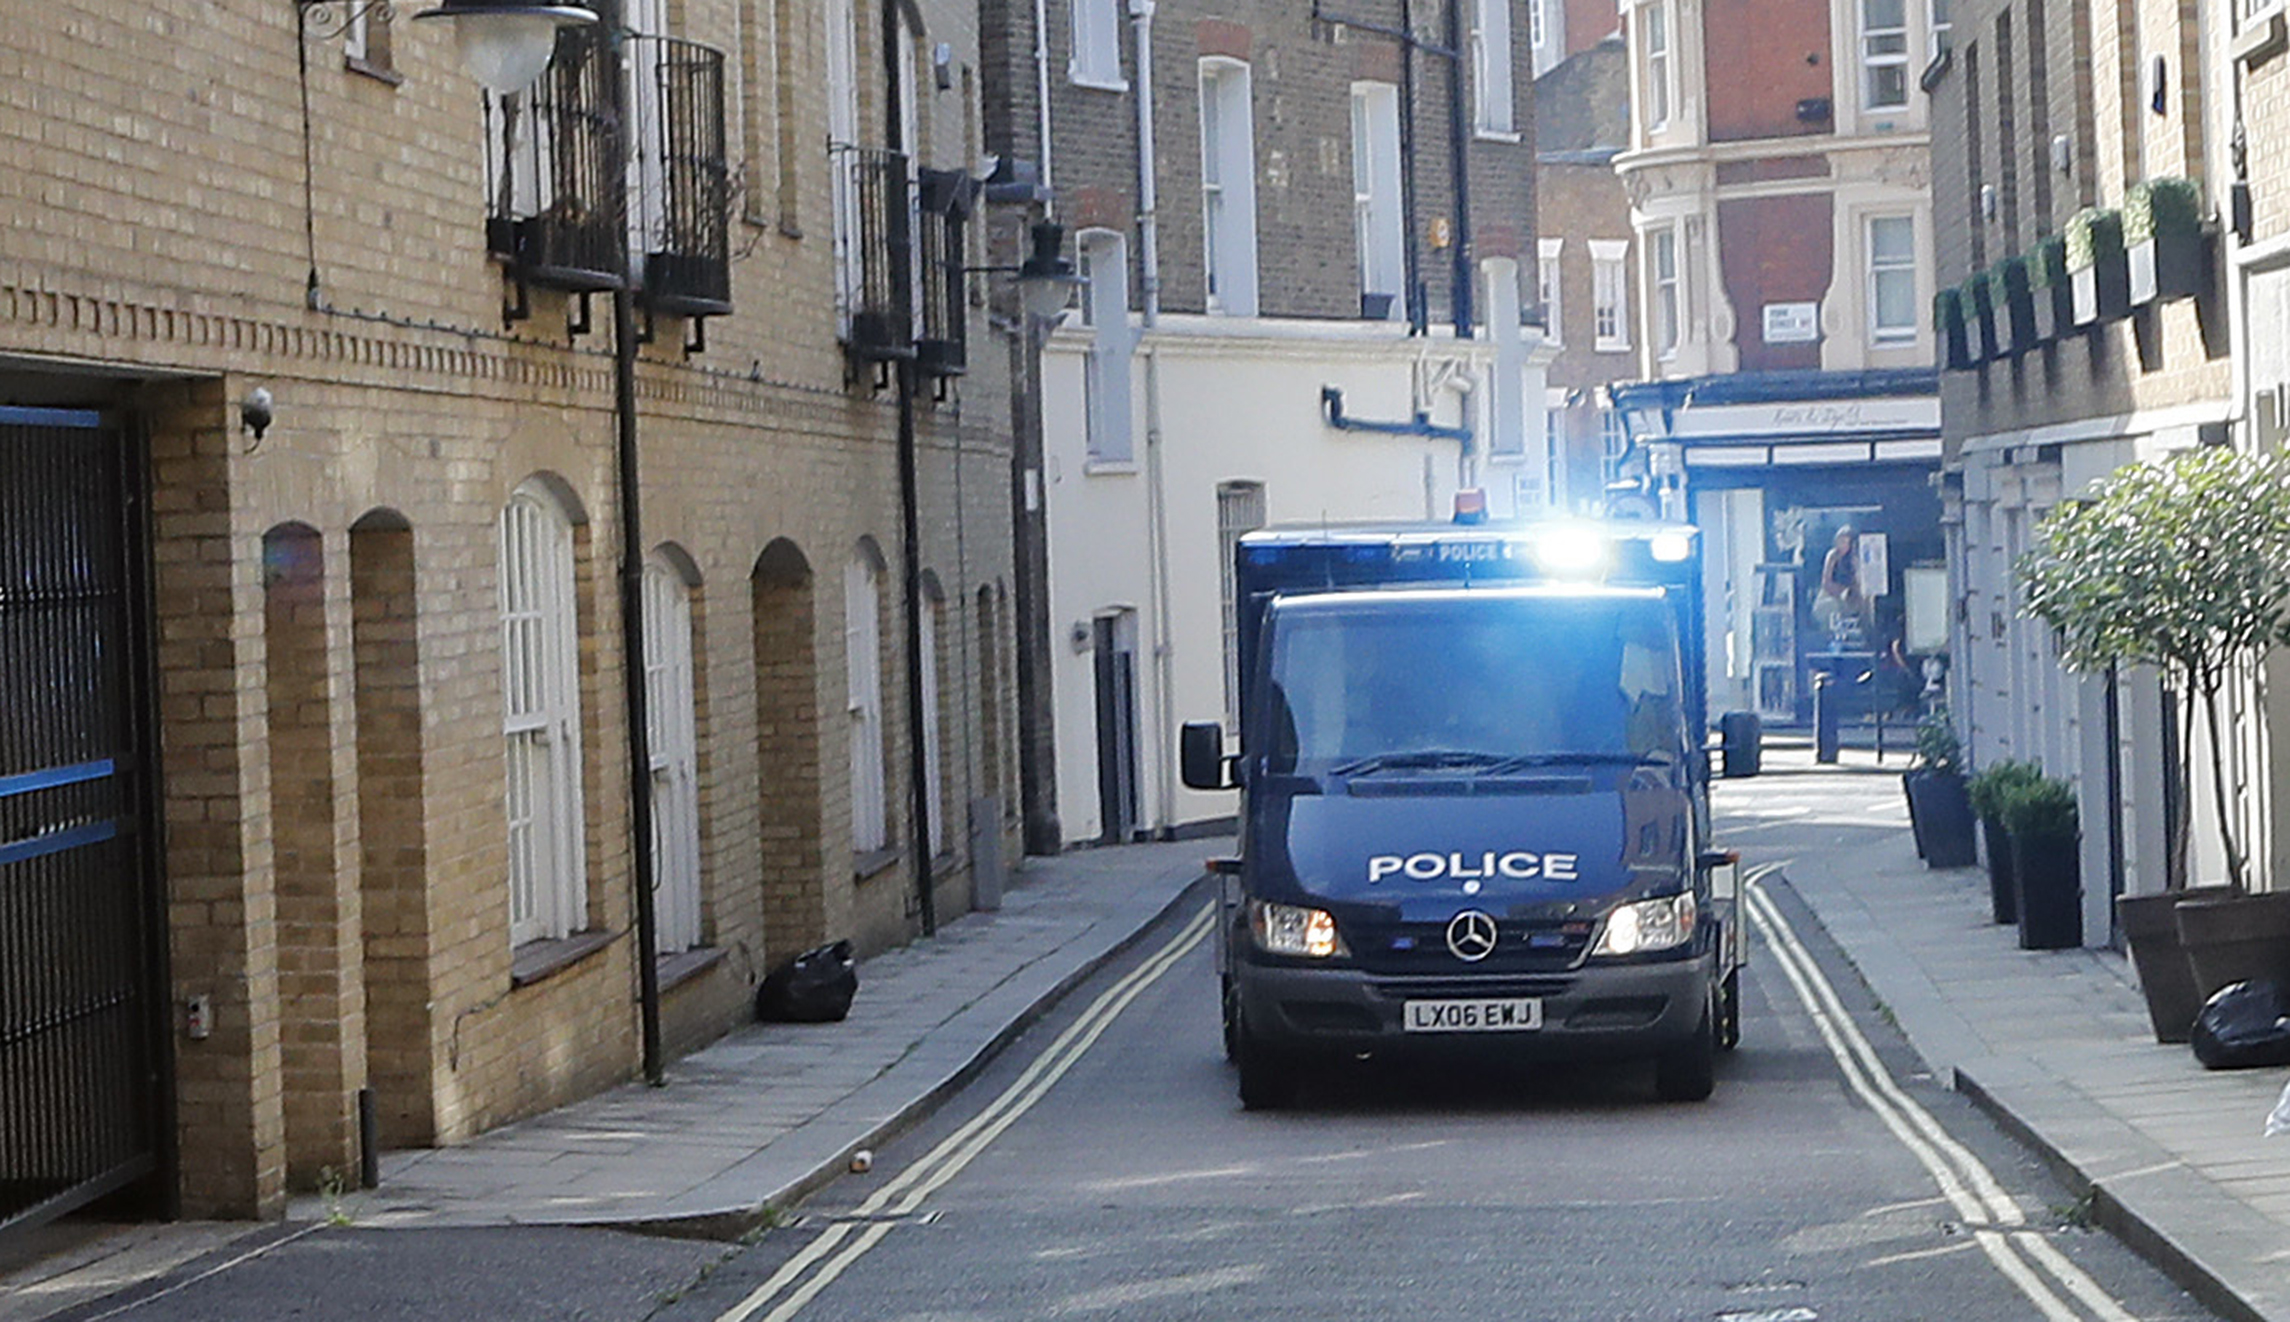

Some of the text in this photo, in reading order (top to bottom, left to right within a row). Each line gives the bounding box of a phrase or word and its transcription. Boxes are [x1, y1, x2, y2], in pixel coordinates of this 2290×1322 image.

[1439, 544, 1498, 561] POLICE
[1368, 852, 1579, 883] POLICE
[1414, 1002, 1532, 1027] LX06 EWJ
